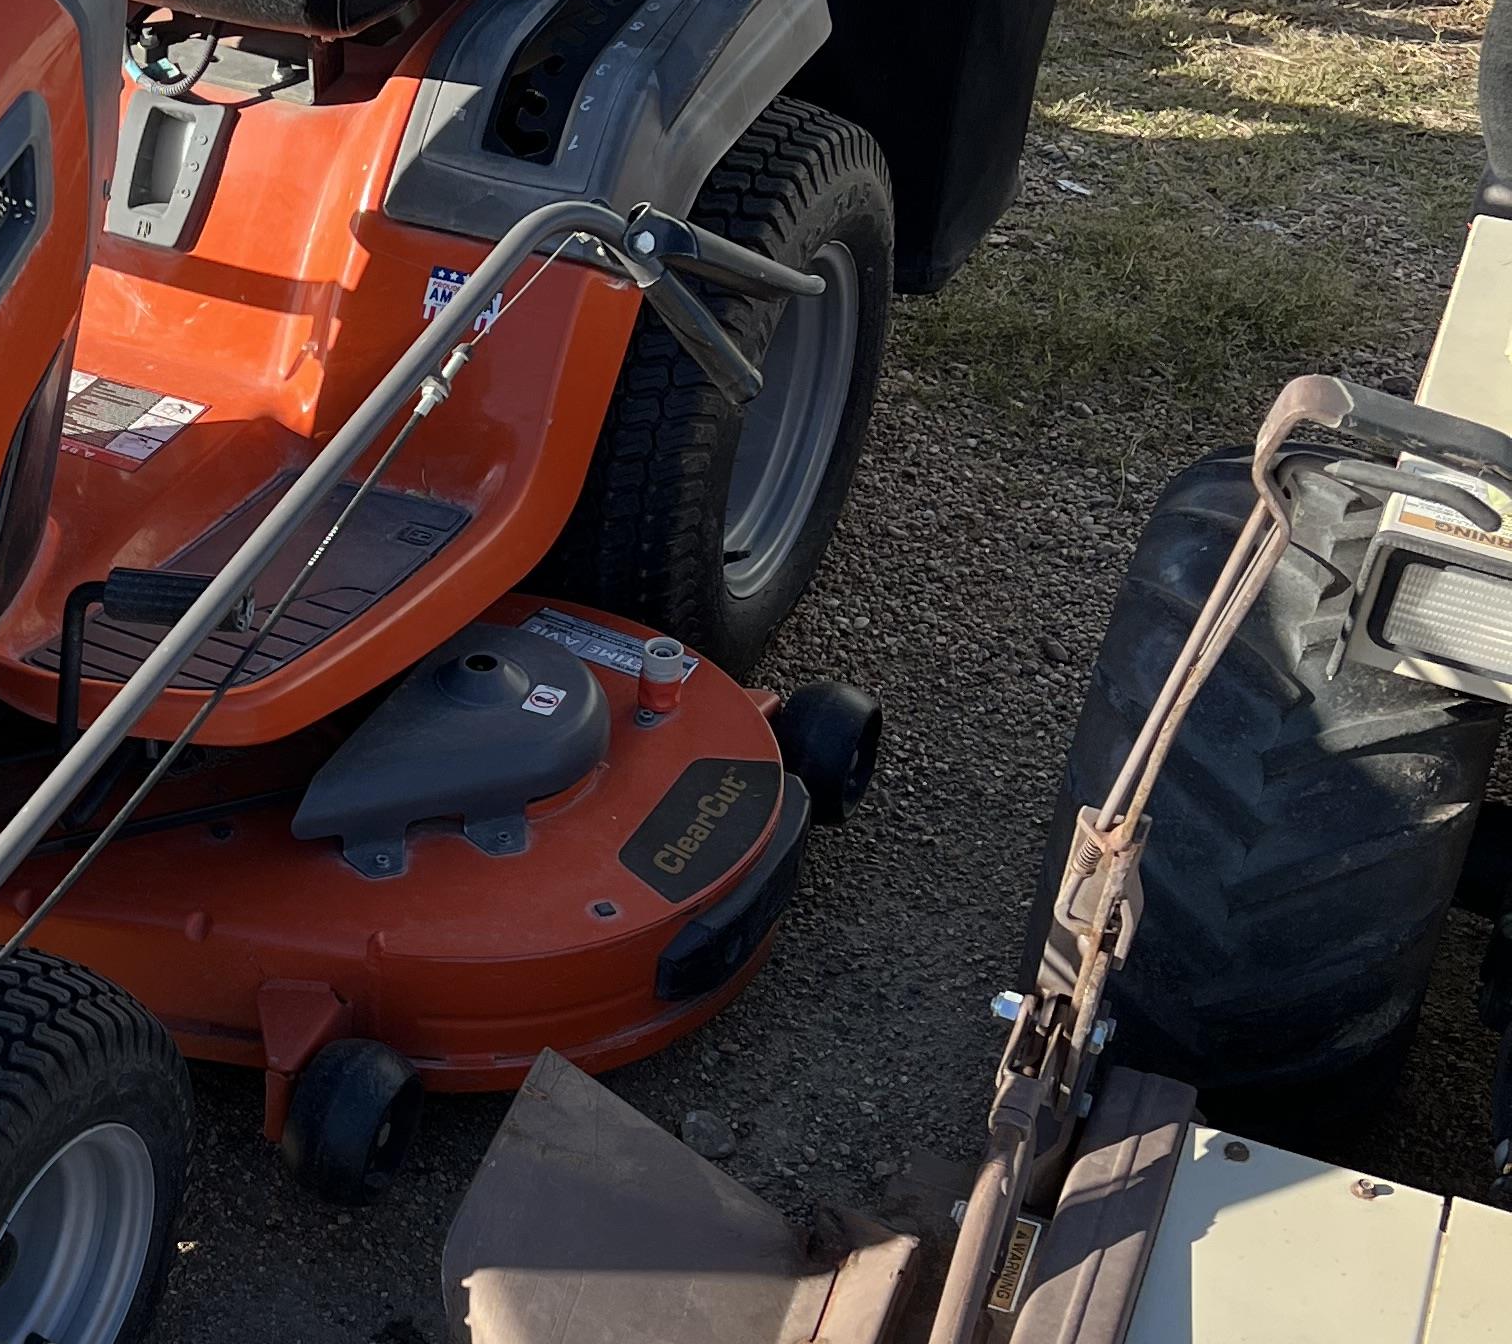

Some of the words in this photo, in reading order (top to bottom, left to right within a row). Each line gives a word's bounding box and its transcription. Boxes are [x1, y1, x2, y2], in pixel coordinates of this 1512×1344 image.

[595, 63, 611, 76] 3
[579, 95, 595, 111] 2
[1435, 520, 1512, 549] RNING
[587, 644, 643, 670] TIME
[653, 773, 747, 875] ClearCut
[996, 1242, 1028, 1299] WARNING
